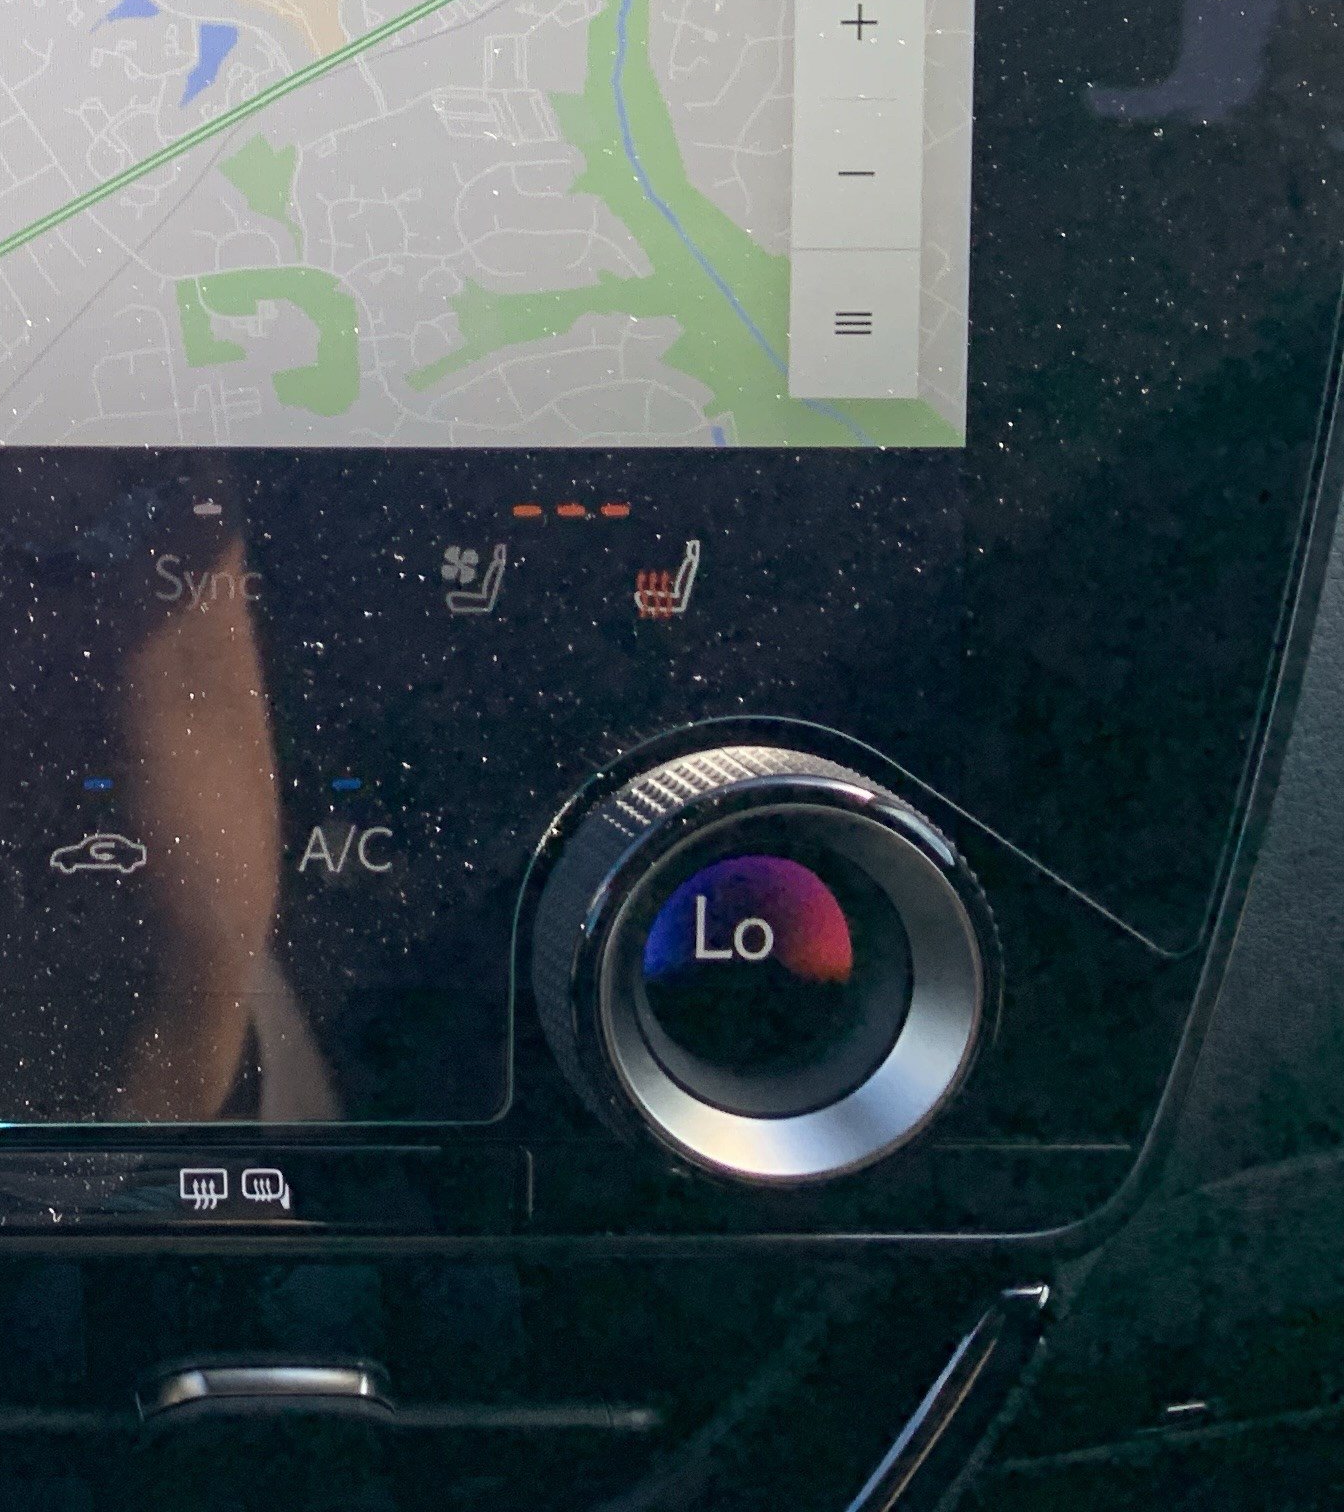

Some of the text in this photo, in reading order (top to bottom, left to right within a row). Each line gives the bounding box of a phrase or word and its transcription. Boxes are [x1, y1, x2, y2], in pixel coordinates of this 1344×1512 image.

[155, 554, 261, 610] Sync
[299, 827, 394, 873] A/C
[694, 895, 774, 960] Lo
